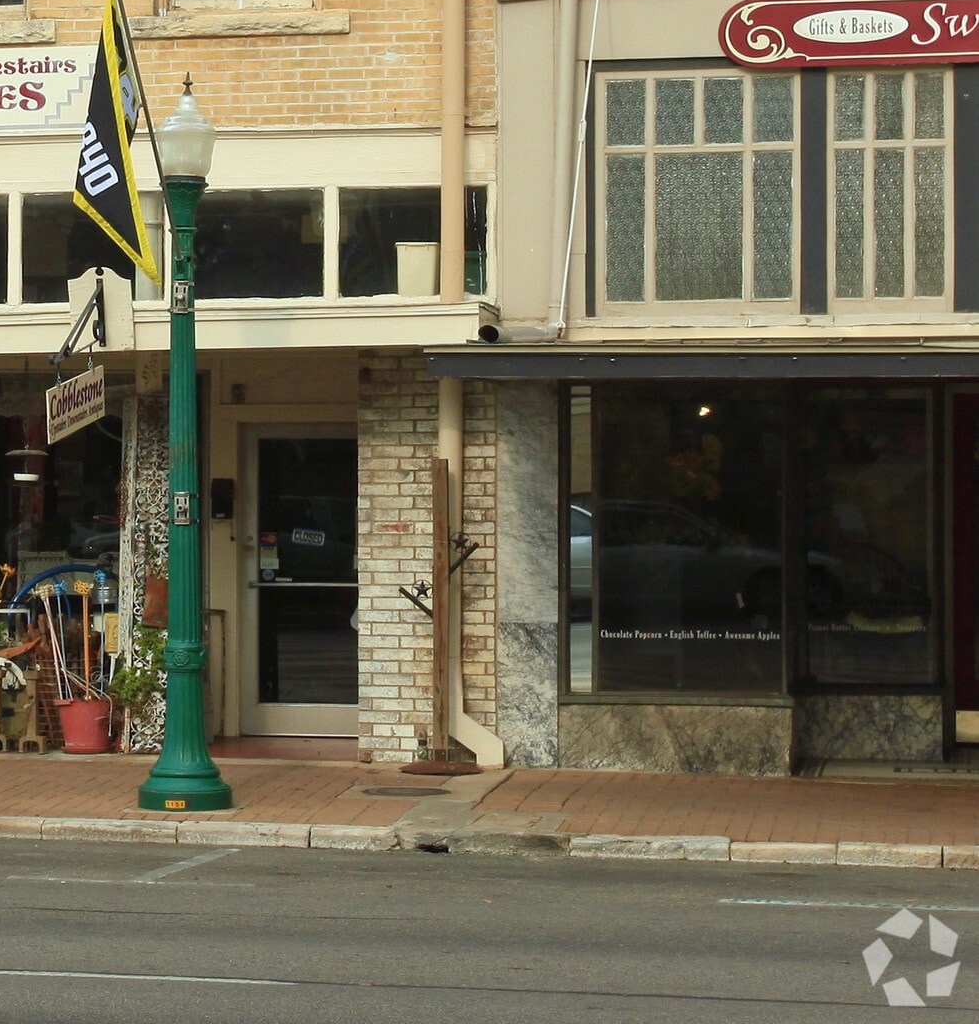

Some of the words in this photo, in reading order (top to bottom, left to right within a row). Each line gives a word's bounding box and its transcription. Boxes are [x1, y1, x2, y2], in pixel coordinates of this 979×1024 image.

[809, 18, 834, 36] Gifts
[839, 17, 847, 34] &
[852, 16, 893, 34] Baskets
[50, 378, 103, 421] Cobblestone
[294, 530, 323, 544] CLOSED
[600, 629, 633, 639] Chocolate
[634, 629, 663, 640] Popcorn
[669, 629, 694, 640] English
[696, 629, 716, 639] Toffee
[724, 630, 755, 640] Awesome
[757, 631, 781, 641] Apples
